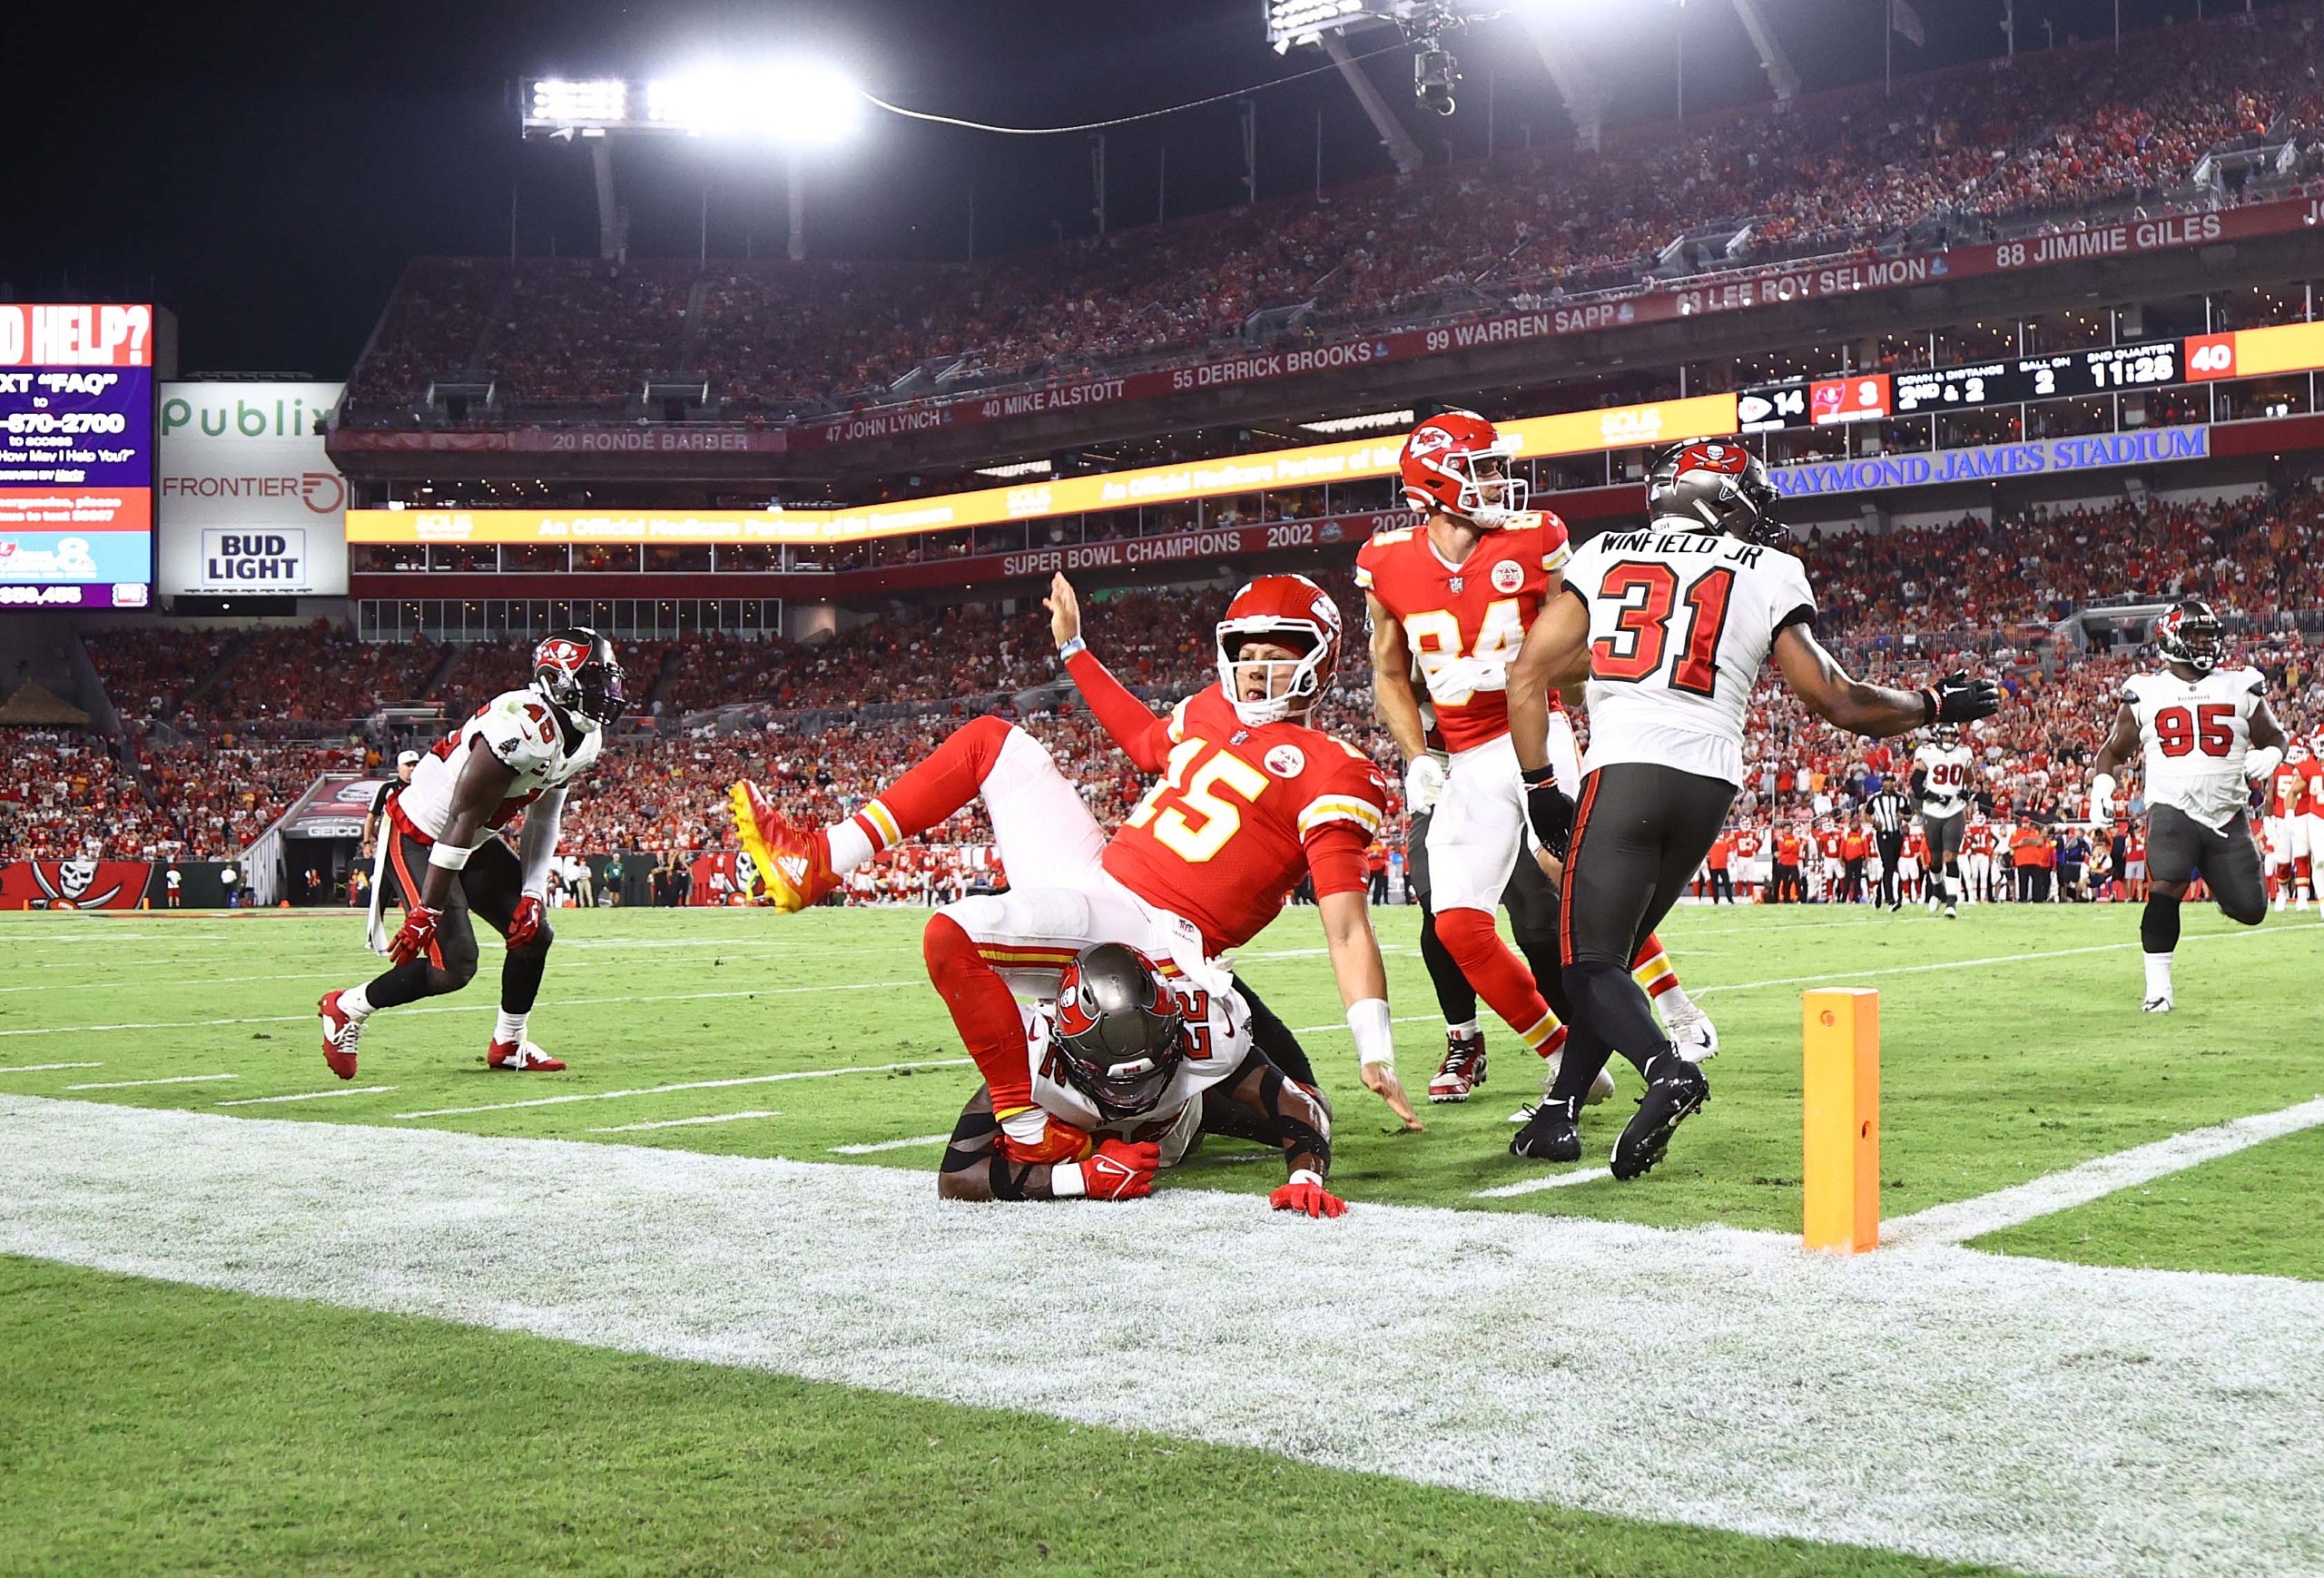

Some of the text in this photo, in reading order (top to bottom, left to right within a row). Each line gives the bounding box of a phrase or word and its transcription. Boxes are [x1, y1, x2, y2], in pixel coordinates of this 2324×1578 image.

[1996, 213, 2221, 268] 88 JIMMIE GILES
[1708, 282, 1753, 311] LEE
[1762, 273, 1812, 301] ROY
[1818, 256, 1926, 293] SELMON
[33, 305, 149, 365] HELP?
[1426, 304, 1614, 351] 99 WARREN SAPP
[2019, 356, 2071, 372] BALL ON
[2114, 343, 2175, 360] QUARTER
[2191, 344, 2231, 370] 40
[1173, 341, 1372, 390] 55 DERRICK BROOKS
[1897, 374, 1933, 387] DOWN
[1945, 365, 2004, 380] DISTANCE
[1858, 381, 1878, 406] 3
[1898, 382, 1940, 409] 2ND
[1965, 378, 1984, 402] 2
[2034, 369, 2055, 395] 2
[33, 397, 49, 408] to
[982, 380, 1125, 418] 40 MIKE ALSTOTT
[1773, 390, 1805, 416] 14
[826, 409, 940, 442] 47 JOHN LYNCH
[553, 430, 748, 451] 20 RONDÉ BARBER
[1769, 426, 2207, 497] RAYMOND JAMES STADIUM
[162, 477, 299, 498] FRONTIER
[538, 518, 568, 537] An
[1372, 510, 1423, 533] 2020
[221, 535, 286, 557] BUD
[1267, 524, 1313, 548] 2002
[1003, 532, 1241, 577] SUPER BOWL CHAMPIONS
[1601, 532, 1764, 570] WINFIELD JR
[208, 557, 299, 579] LIGHT
[1590, 558, 1738, 699] 31
[1403, 597, 1527, 706] 84
[2154, 705, 2236, 758] 95
[1932, 763, 1965, 787] 90
[1124, 735, 1270, 863] 15
[308, 824, 362, 837] GEICO
